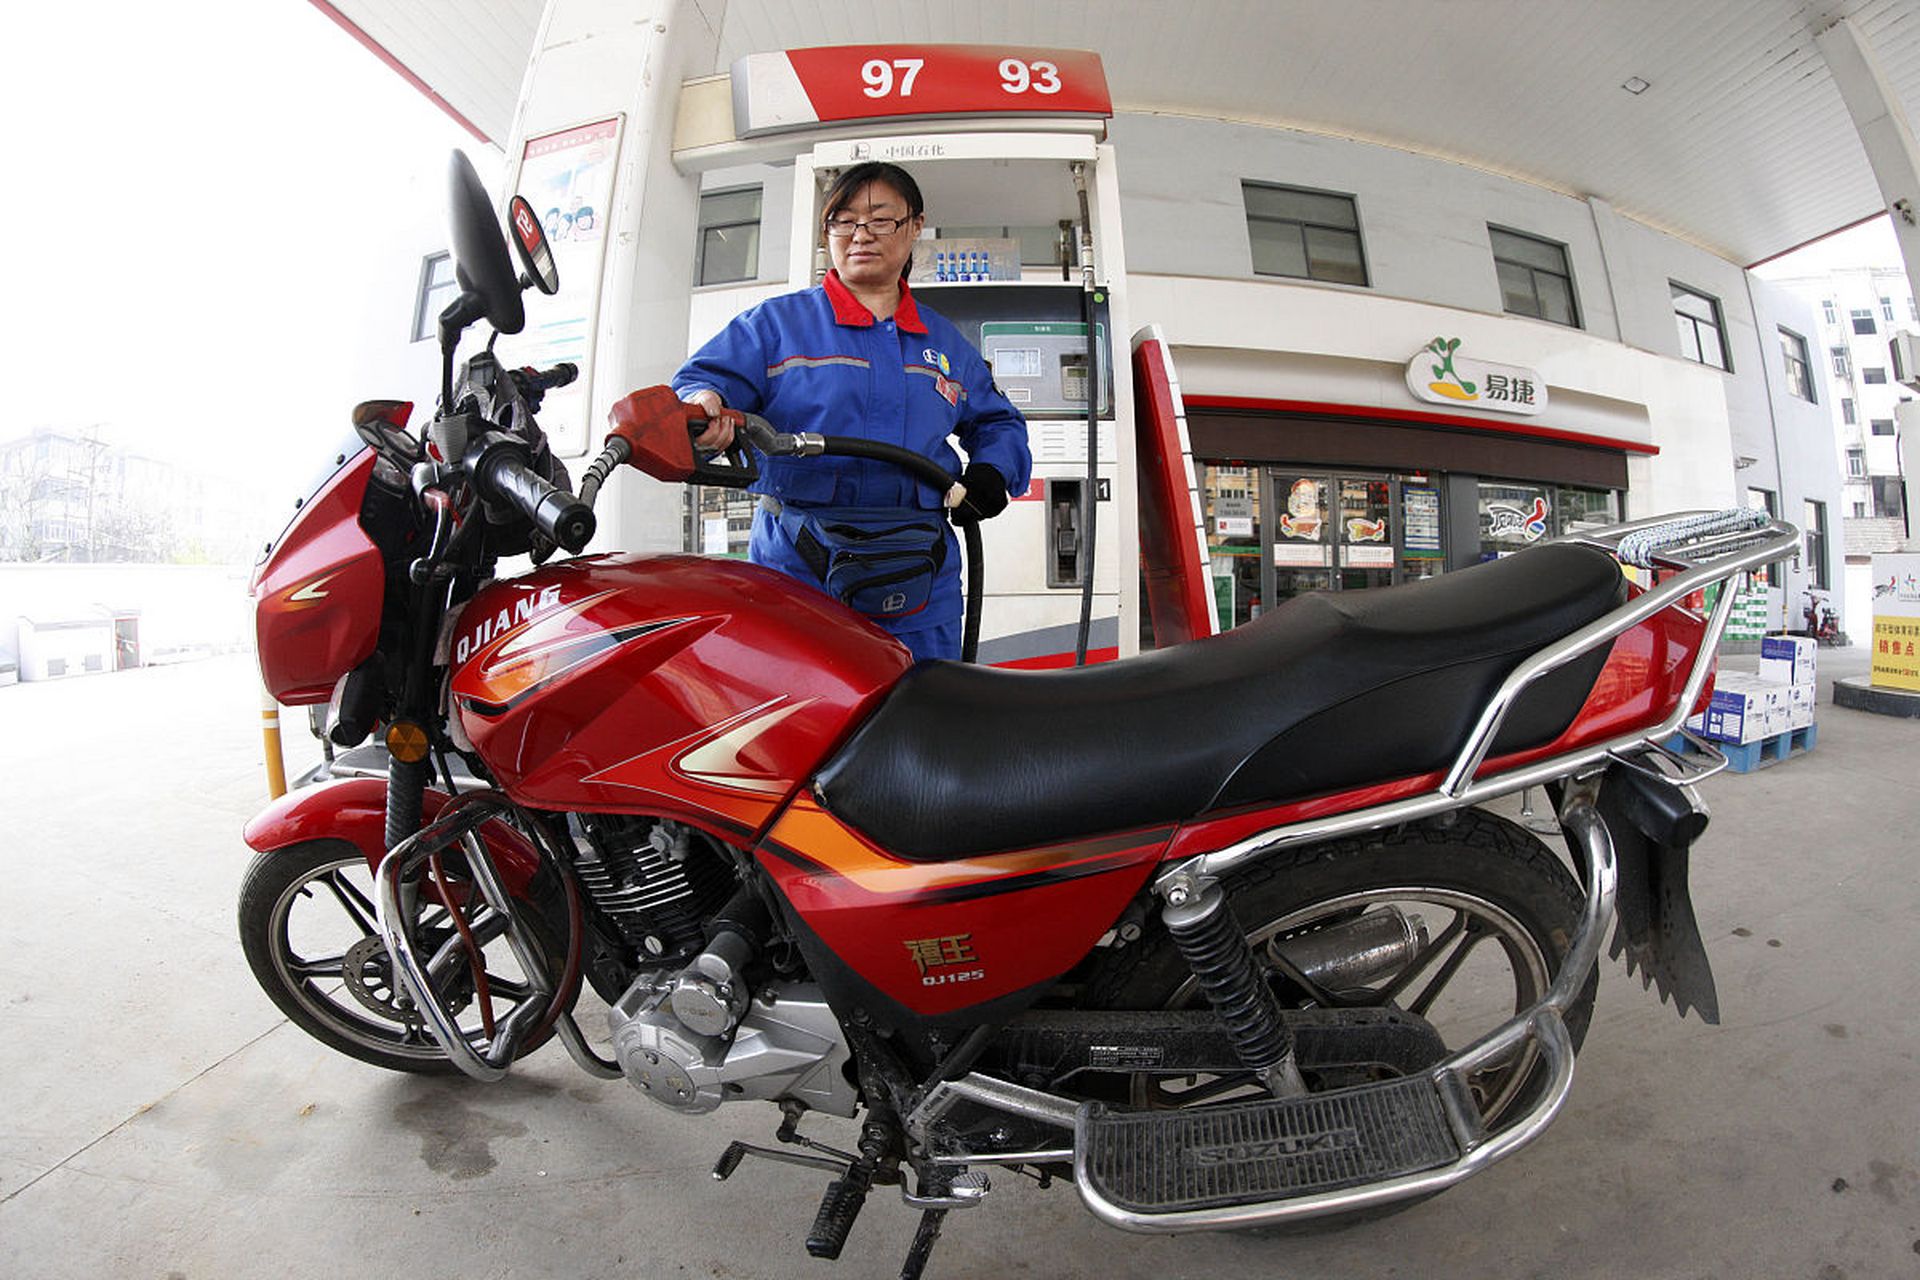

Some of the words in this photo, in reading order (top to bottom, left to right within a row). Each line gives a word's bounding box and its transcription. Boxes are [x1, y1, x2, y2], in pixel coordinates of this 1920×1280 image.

[861, 59, 925, 98] 97
[998, 58, 1062, 94] 93
[885, 145, 945, 158] 中国石化
[1485, 374, 1536, 405] 易捷
[457, 583, 563, 665] QJIANG
[922, 969, 985, 986] QJ125
